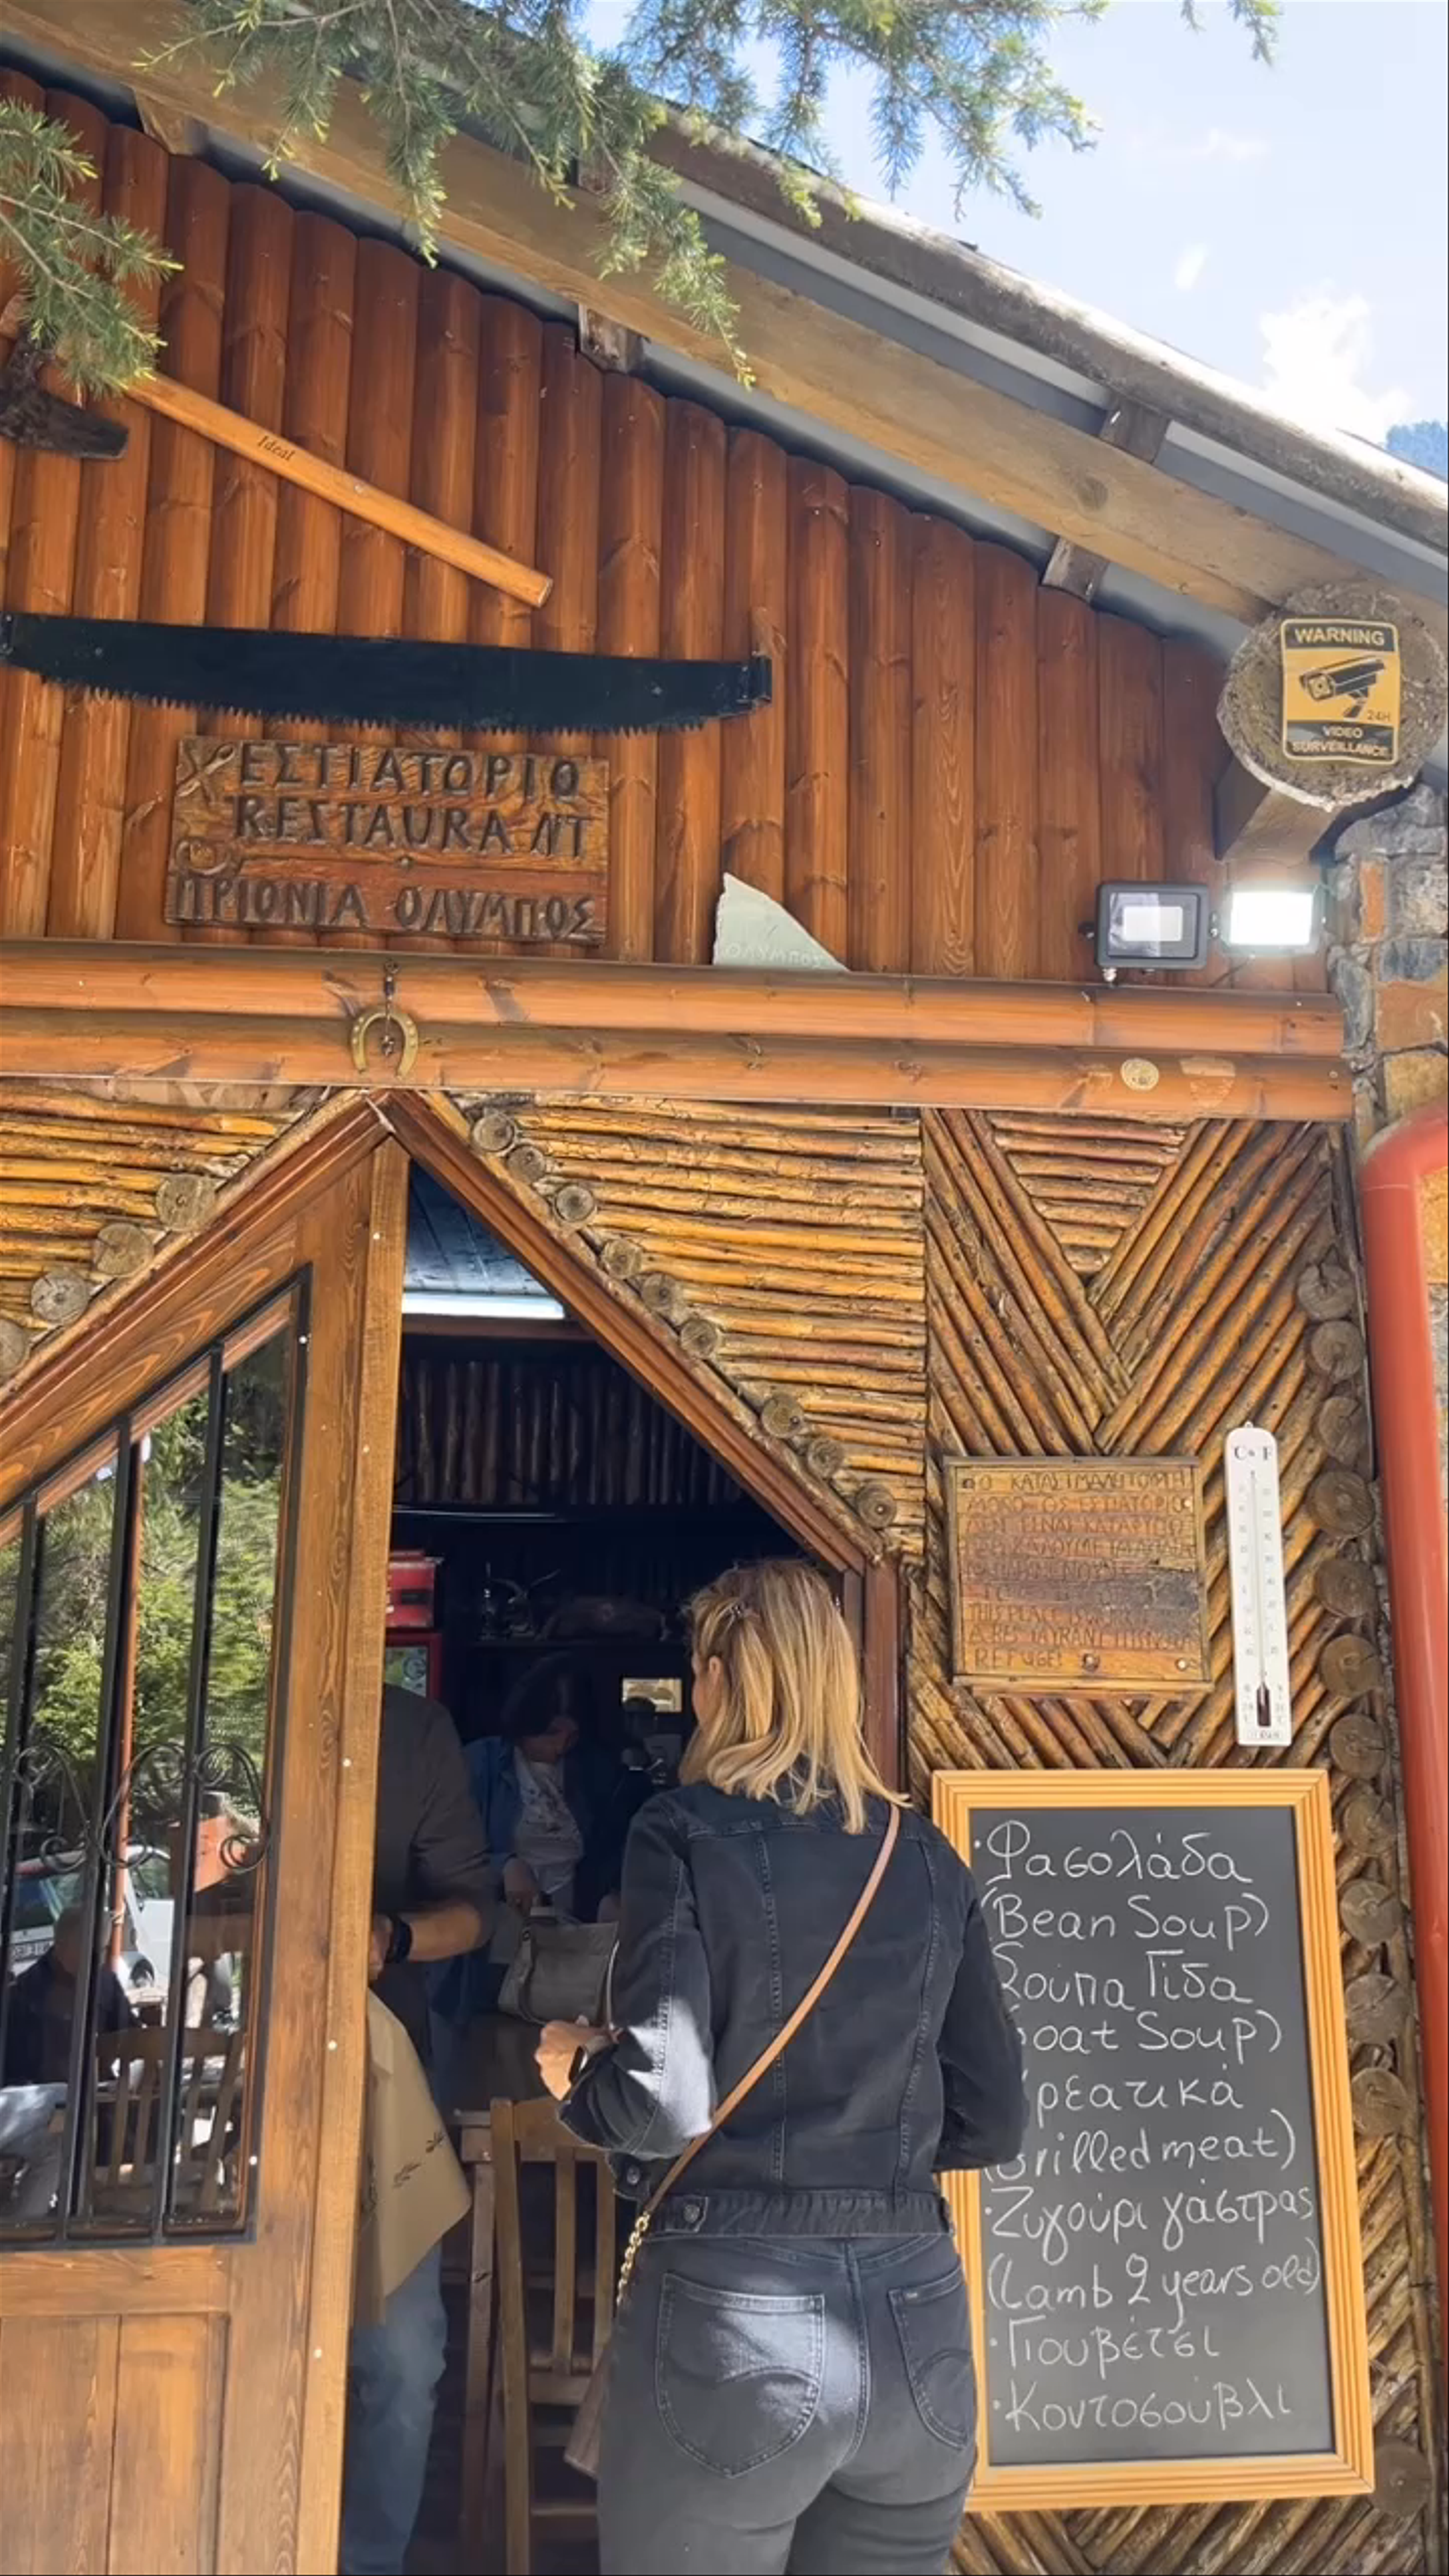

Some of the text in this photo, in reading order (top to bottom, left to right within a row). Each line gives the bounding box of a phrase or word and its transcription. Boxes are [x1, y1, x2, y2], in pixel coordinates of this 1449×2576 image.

[258, 435, 295, 461] Ideal
[1295, 626, 1384, 646] WARNING
[1291, 740, 1388, 757] SURVEILLANCE
[1323, 725, 1363, 738] VIDEO
[174, 875, 600, 941] ΠΡΙΟΝΙΑ ΟΛΥΜΠΟΣ
[986, 1820, 1253, 1885] Φασολάδα
[1127, 1893, 1269, 1951] Soup)
[1146, 1948, 1254, 2004] Γίδα
[1008, 2004, 1282, 2064] oat Soup)
[1021, 2063, 1244, 2128] ρεατικά
[983, 2108, 1296, 2182] rilled meat)
[1126, 2253, 1151, 2304] 2
[1162, 2264, 1254, 2335] years
[1261, 2236, 1320, 2295] old)
